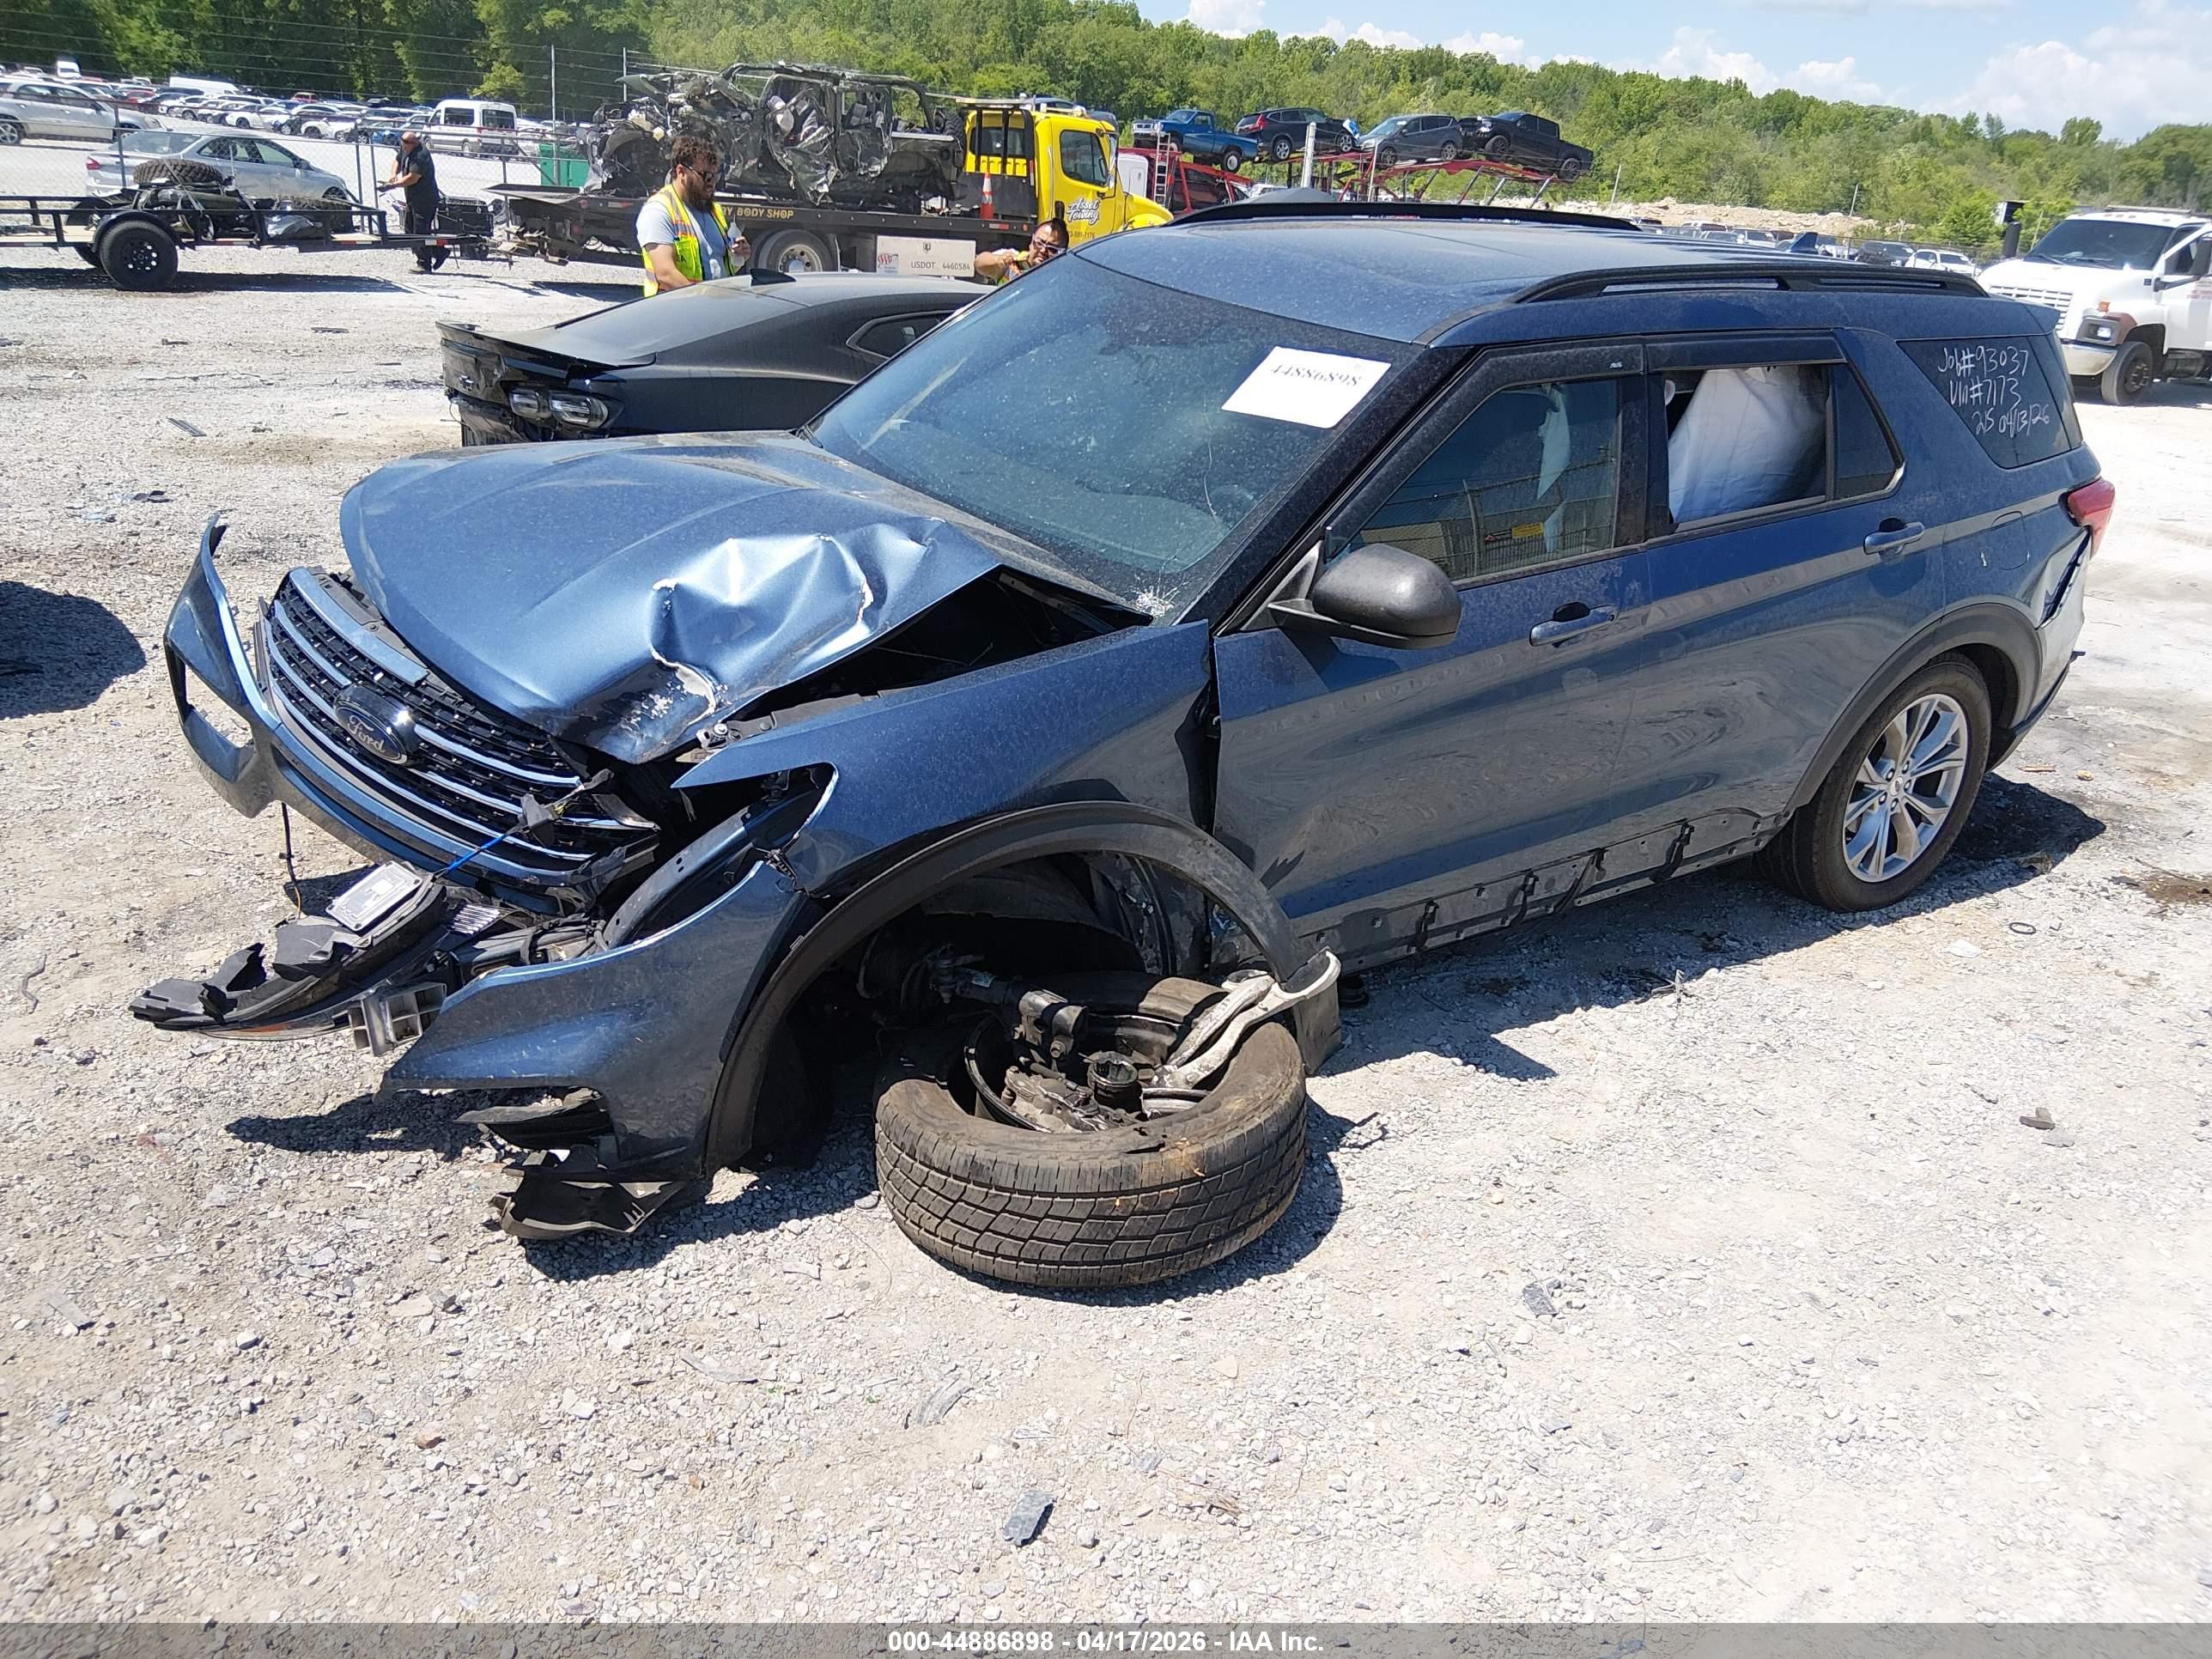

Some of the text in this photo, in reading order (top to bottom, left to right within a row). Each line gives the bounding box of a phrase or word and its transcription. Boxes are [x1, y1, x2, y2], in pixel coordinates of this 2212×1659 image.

[737, 207, 764, 216] BODY
[767, 209, 793, 219] SHOP
[1066, 209, 1099, 225] Towing
[1271, 364, 1362, 386] 44886898
[347, 714, 386, 752] Ford
